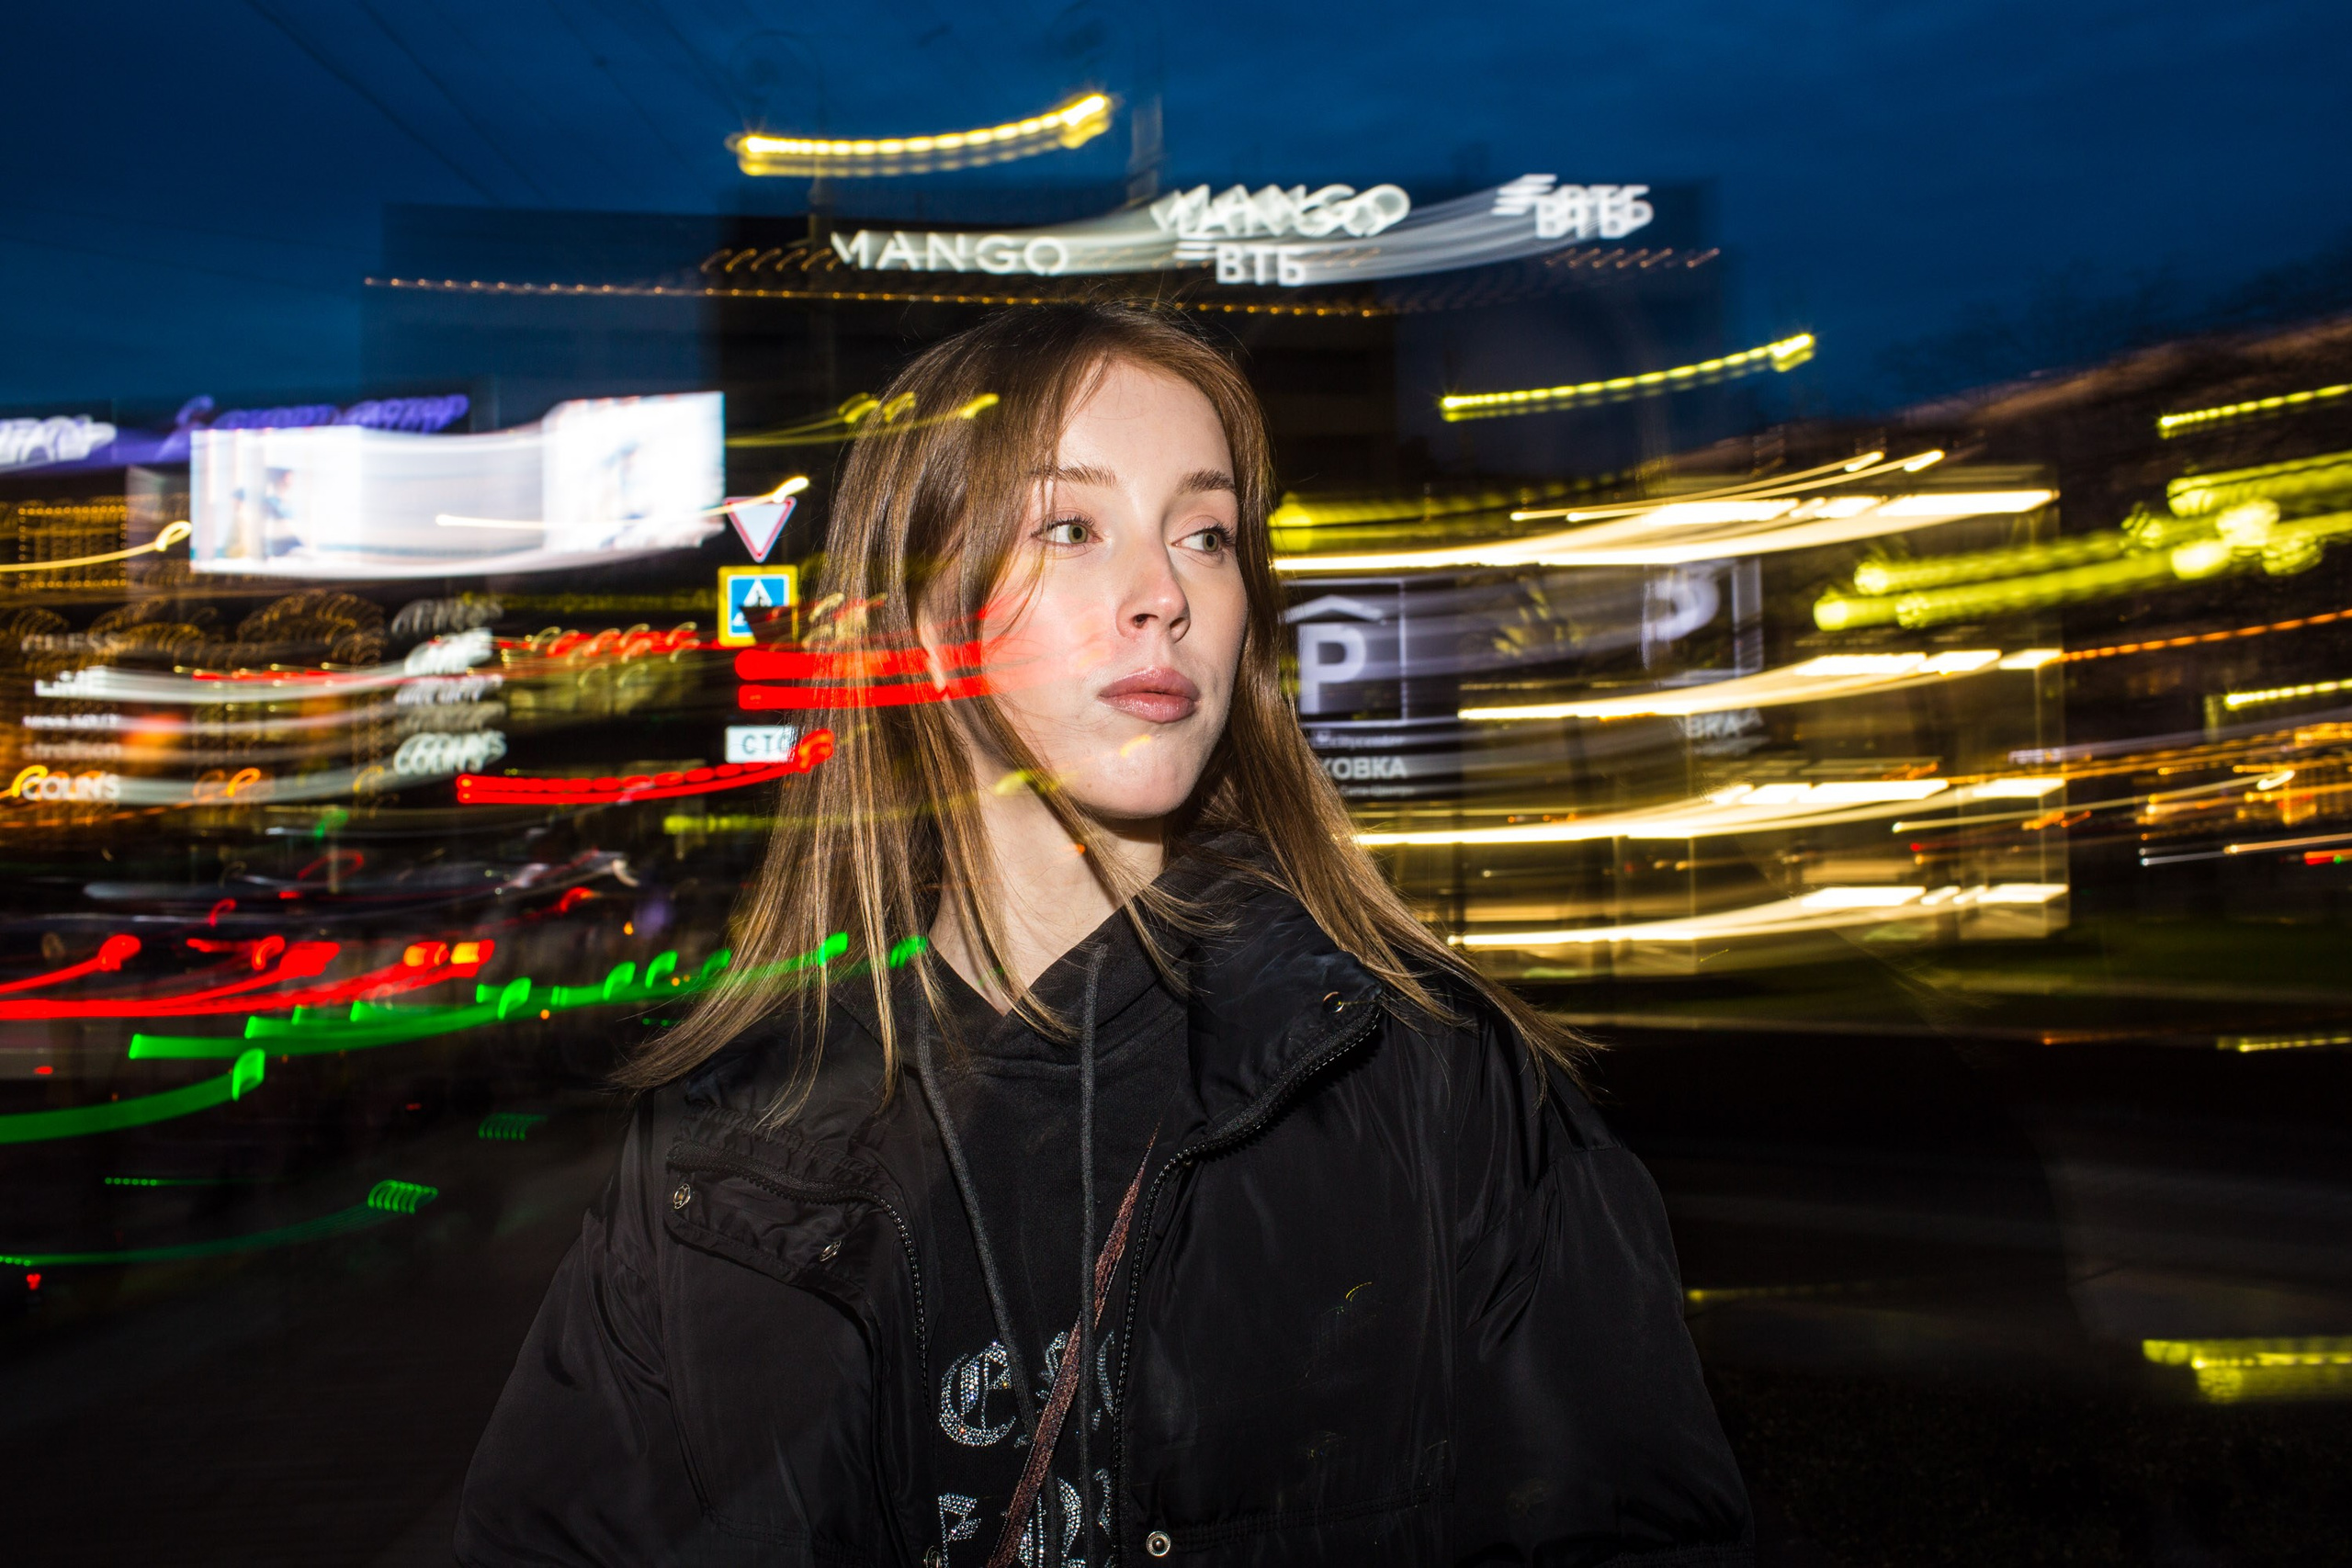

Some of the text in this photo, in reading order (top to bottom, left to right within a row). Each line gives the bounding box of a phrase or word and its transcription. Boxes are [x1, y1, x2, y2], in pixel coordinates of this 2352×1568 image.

[830, 229, 1069, 276] MANGO
[1215, 242, 1306, 287] ВТБ
[741, 734, 795, 755] СТО
